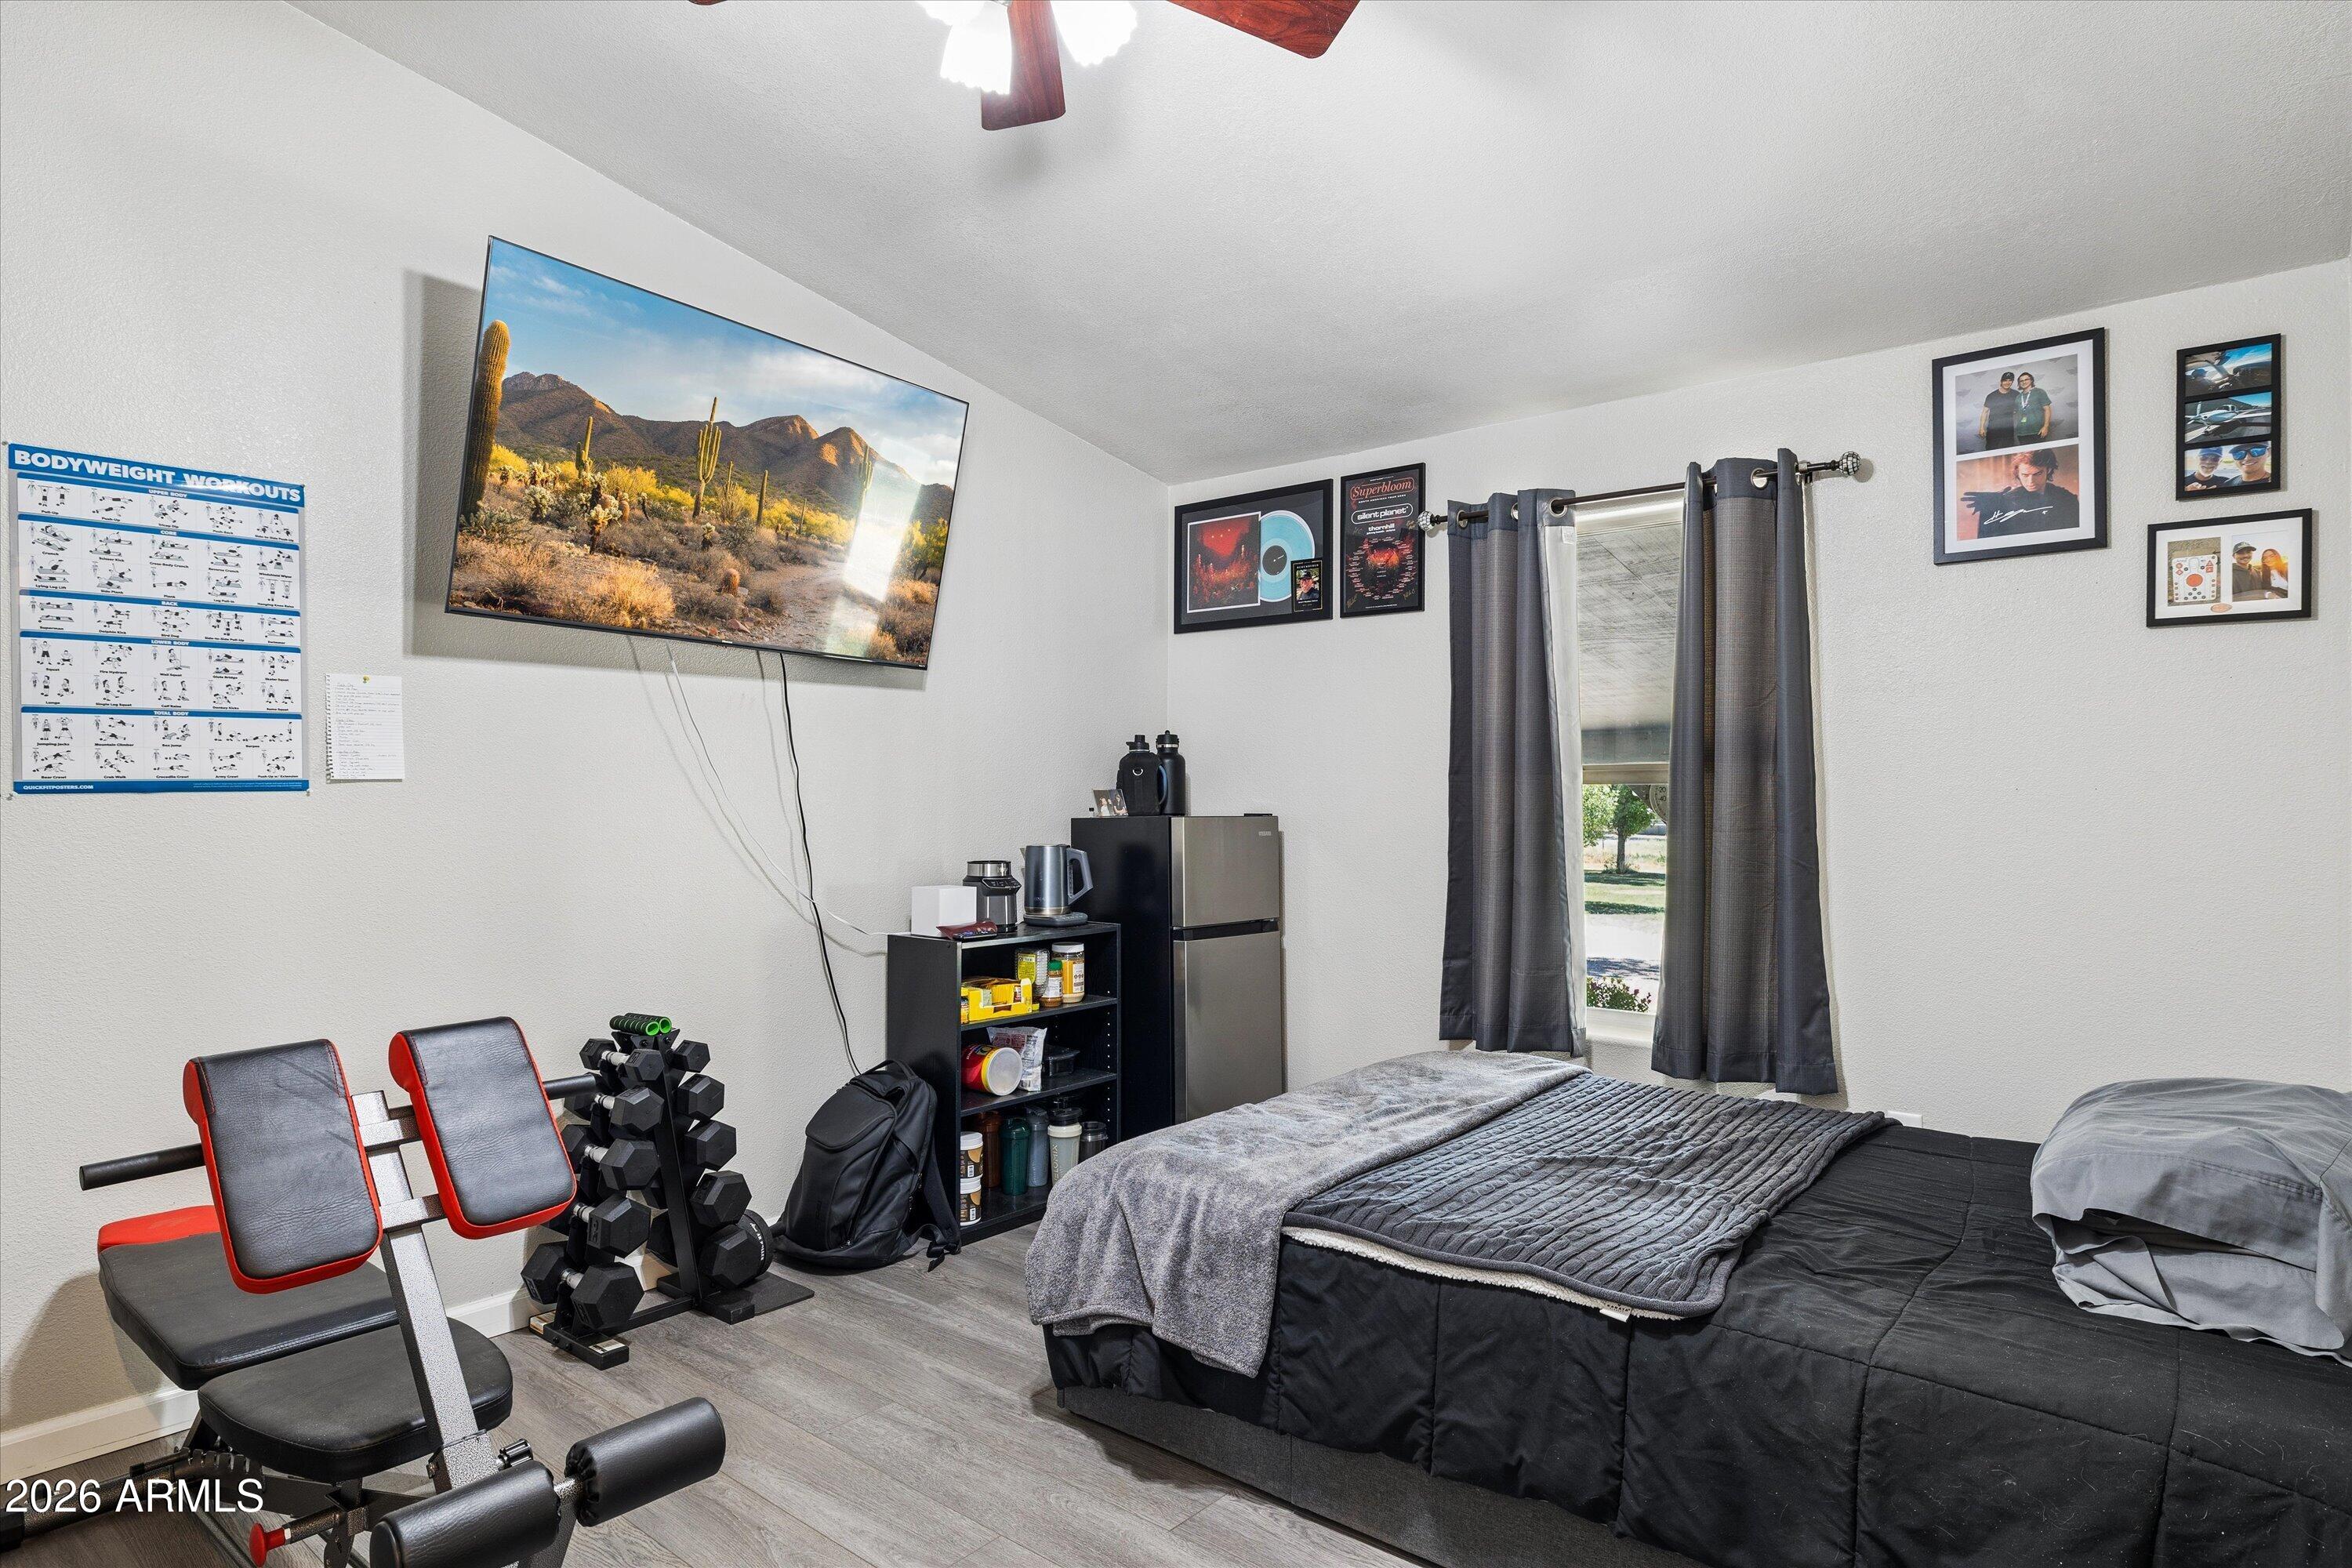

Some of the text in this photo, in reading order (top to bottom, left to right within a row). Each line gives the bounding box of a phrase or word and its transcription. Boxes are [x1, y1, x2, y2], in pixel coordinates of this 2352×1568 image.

[14, 450, 301, 502] BODYWEIGHT WORKOUTS
[1352, 481, 1411, 498] Superbloom
[1357, 511, 1380, 520] silent
[1368, 523, 1395, 532] thornhill
